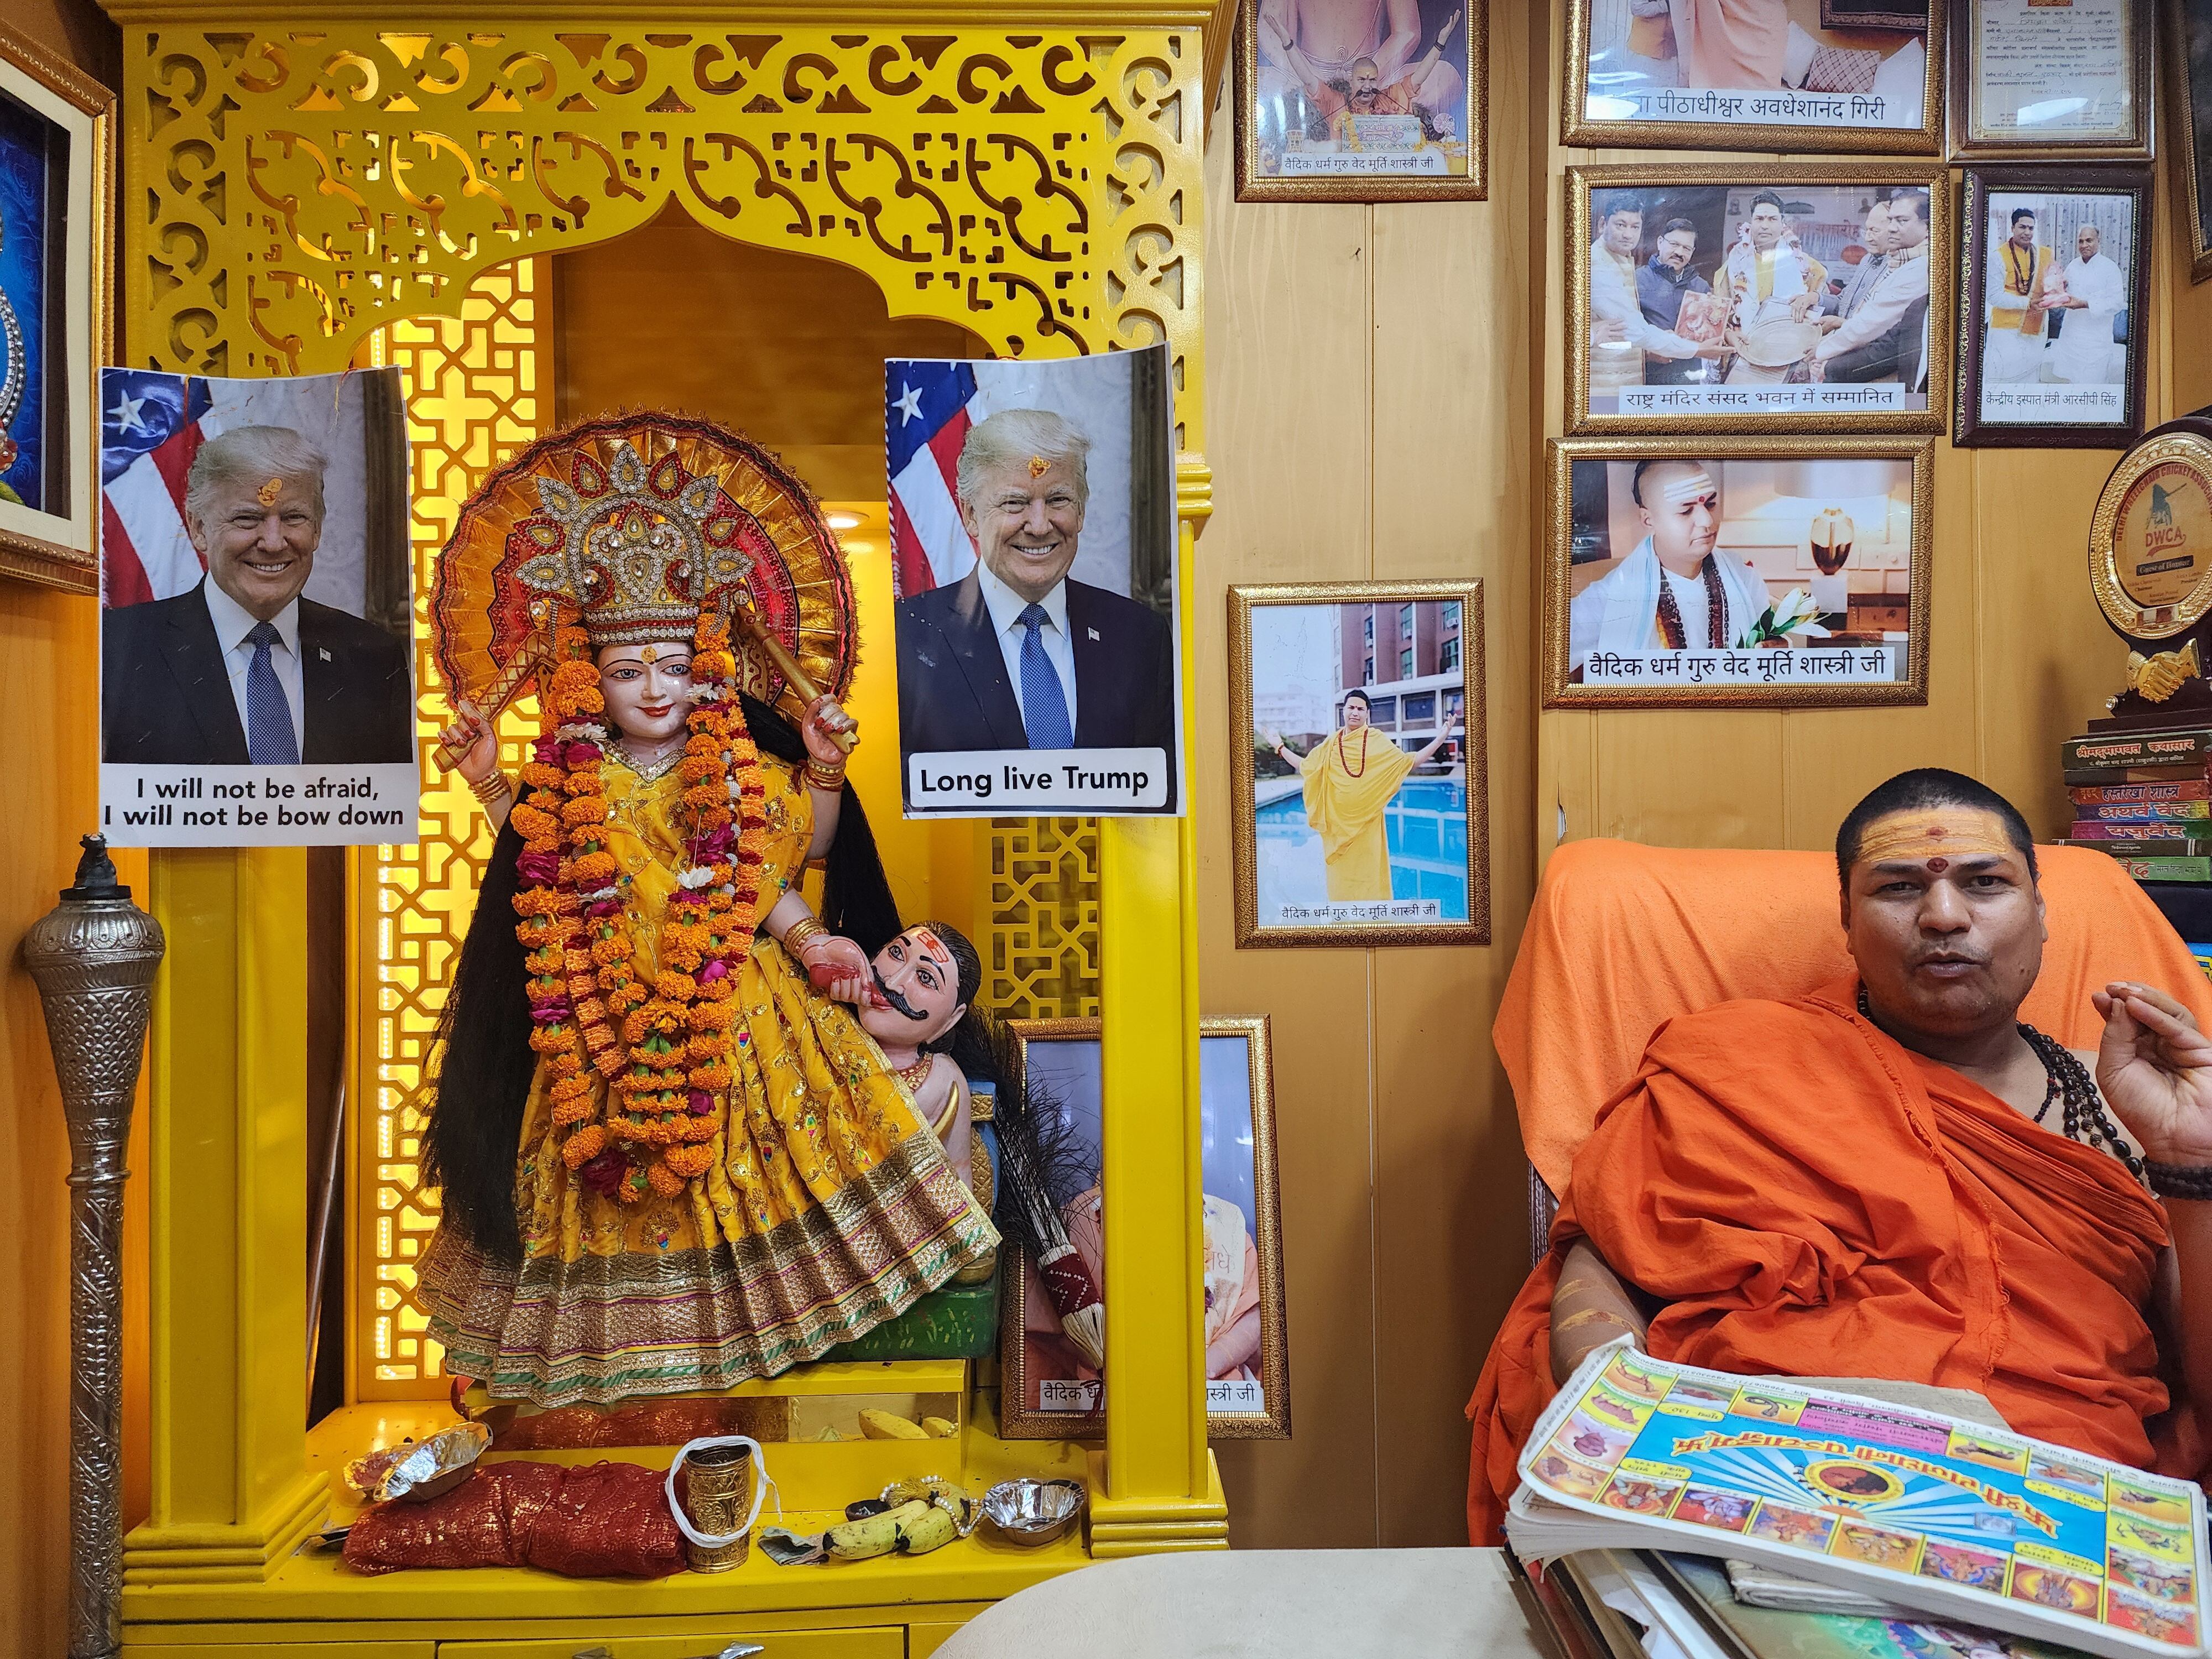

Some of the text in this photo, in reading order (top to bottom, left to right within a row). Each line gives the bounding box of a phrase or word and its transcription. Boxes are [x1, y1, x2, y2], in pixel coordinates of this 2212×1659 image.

[1657, 90, 1744, 118] पीठाधीश्वर
[1750, 93, 1845, 119] अवधेशानंद
[1850, 96, 1886, 120] गिरी
[1285, 156, 1433, 172] वैदिक धर्म गुरु वेद मूर्ति शास्त्री जी
[1626, 388, 1893, 408] राष्ट्र मंदिर संसद भवन में सम्मानित
[1986, 391, 2117, 407] केन्द्रीय इस्पात मंत्री आरसीपी सिंह
[2161, 463, 2191, 477] CRICKET
[2146, 525, 2182, 547] DWCA
[1589, 650, 1886, 682] वैदिक धर्म गुरु वेद मूर्ति शास्त्री जी
[138, 776, 379, 801] I will not be afraid,
[921, 765, 1149, 797] Long live Trump
[2102, 785, 2146, 801] हस्तरेखा
[2149, 784, 2180, 800] शास्त्र
[105, 804, 404, 825] I will not be bow down
[2099, 802, 2190, 818] अथर्व वेद
[2105, 822, 2186, 839] यजुर्वेद
[1282, 903, 1436, 921] वैदिक धर्म गुरु वेद मूर्ति शास्त्री जी
[1044, 1382, 1083, 1401] वैदिक
[1237, 1383, 1255, 1401] जी
